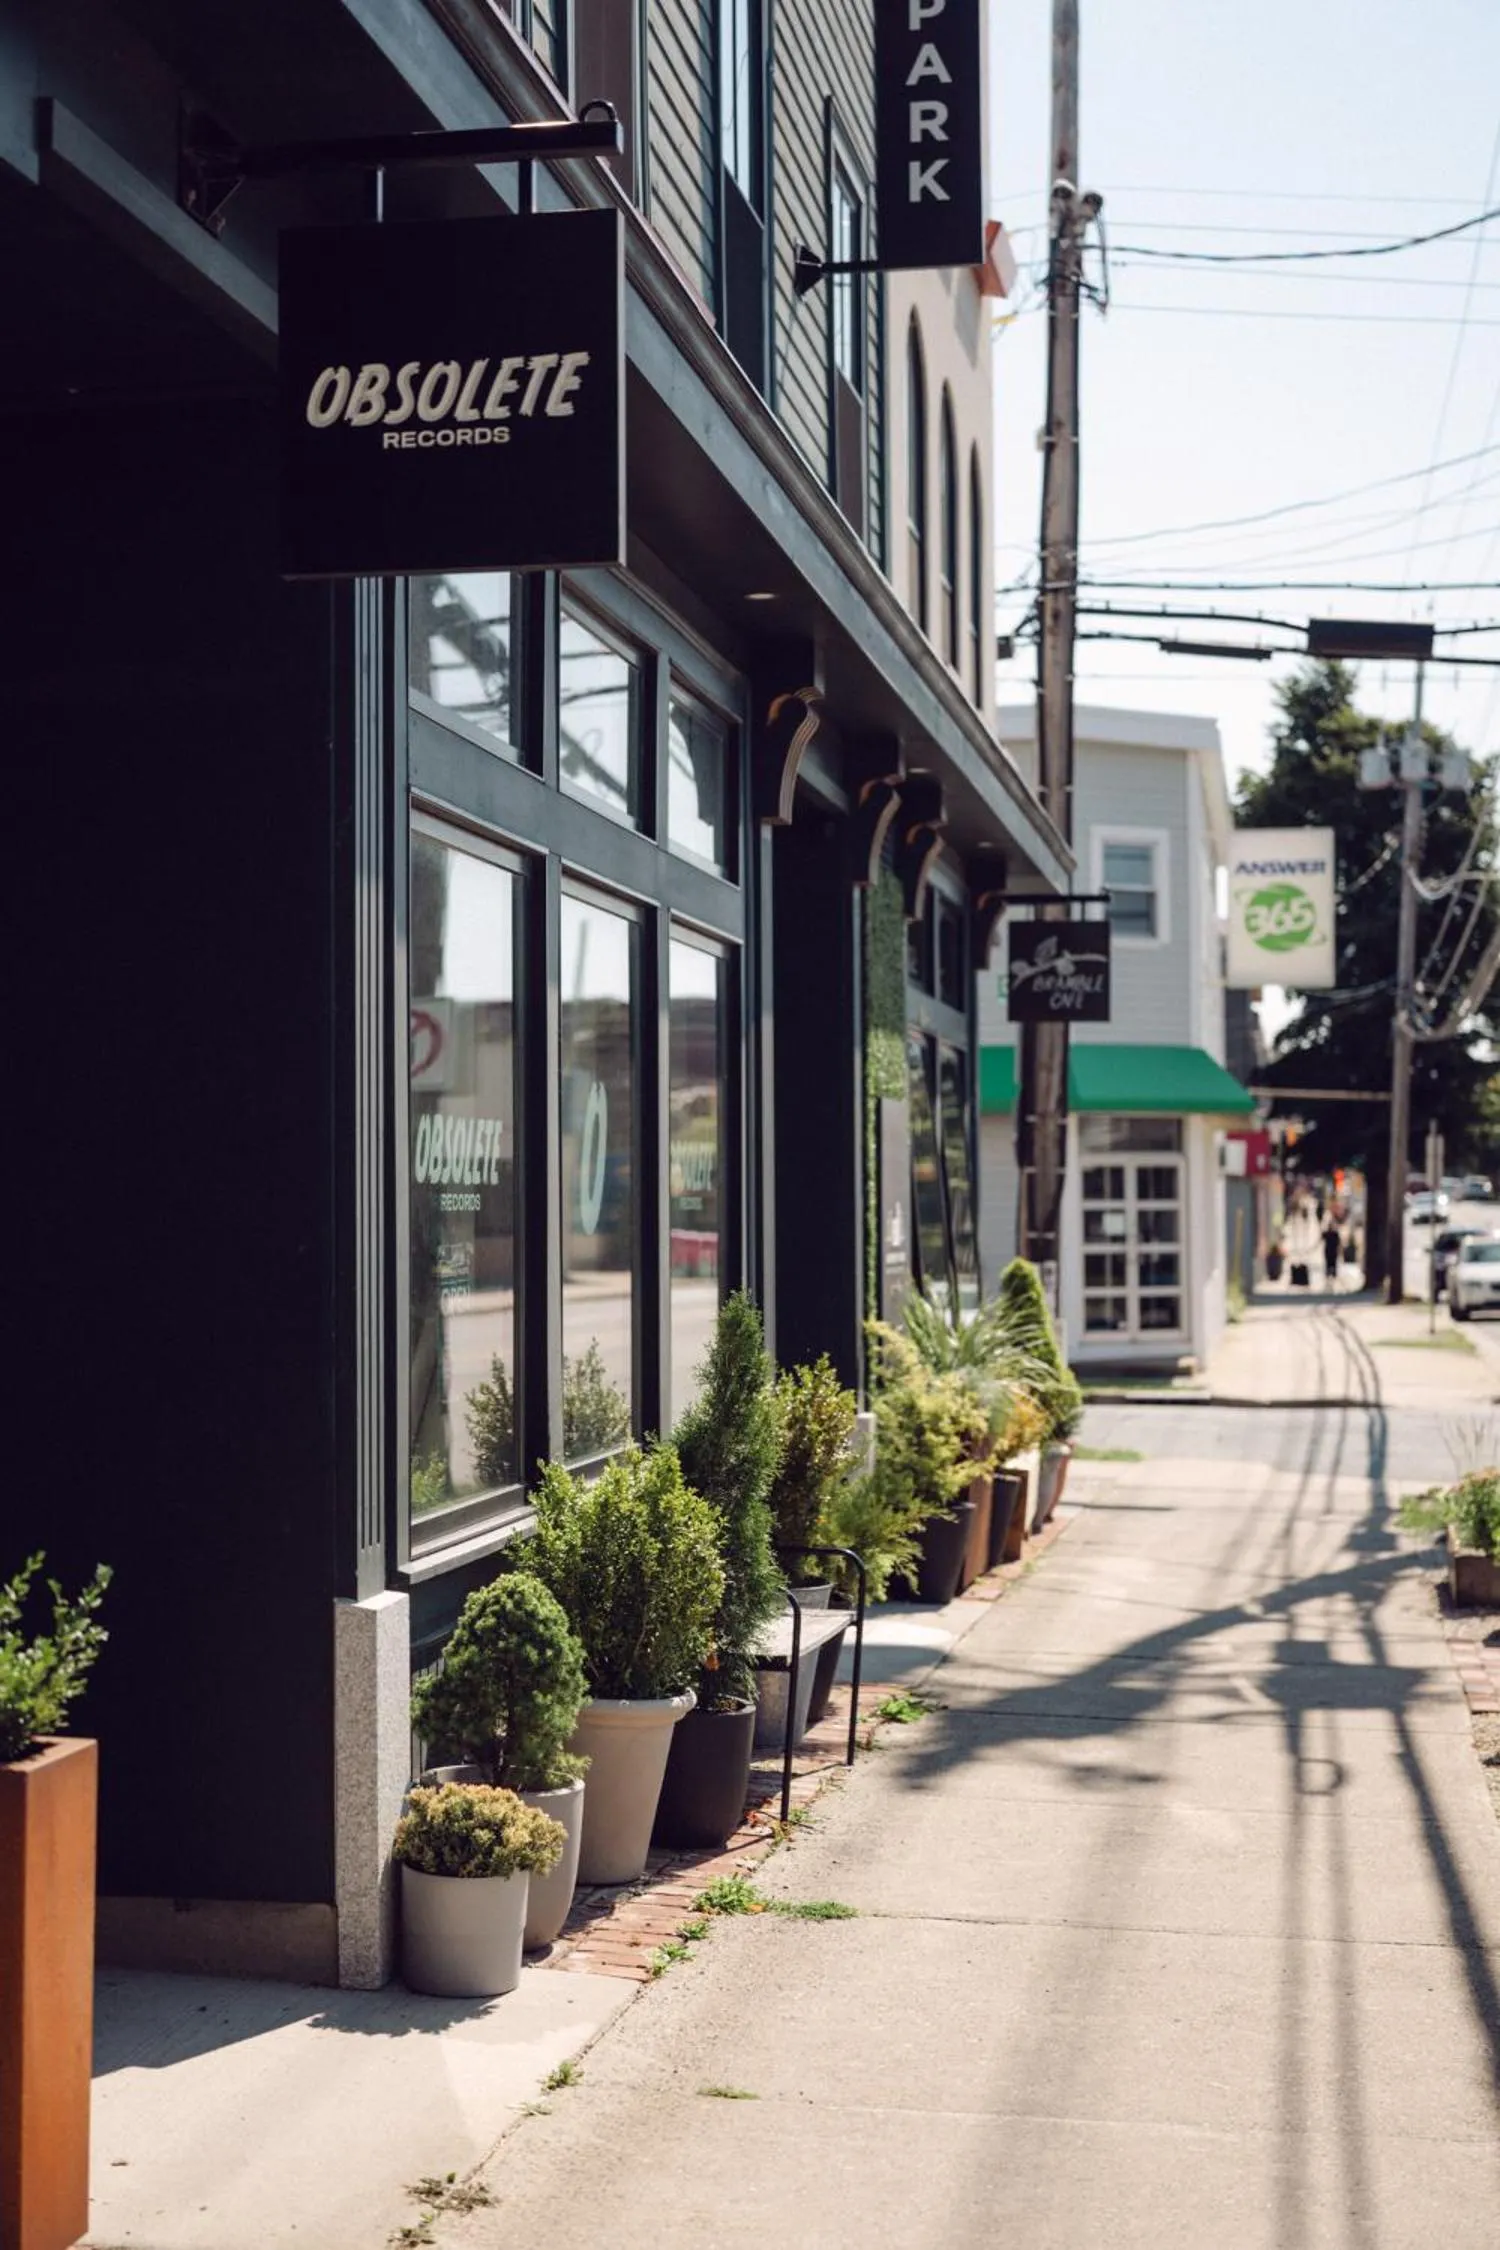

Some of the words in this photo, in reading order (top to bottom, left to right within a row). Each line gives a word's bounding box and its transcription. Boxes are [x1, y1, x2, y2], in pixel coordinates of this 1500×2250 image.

[905, 0, 952, 204] PARK
[306, 351, 590, 428] OBSOLETE
[382, 426, 511, 449] RECORDS
[1235, 860, 1326, 875] ANSWER
[1246, 896, 1315, 941] 365
[415, 1113, 503, 1186] OBSOLETE
[440, 1193, 481, 1211] RECORDS
